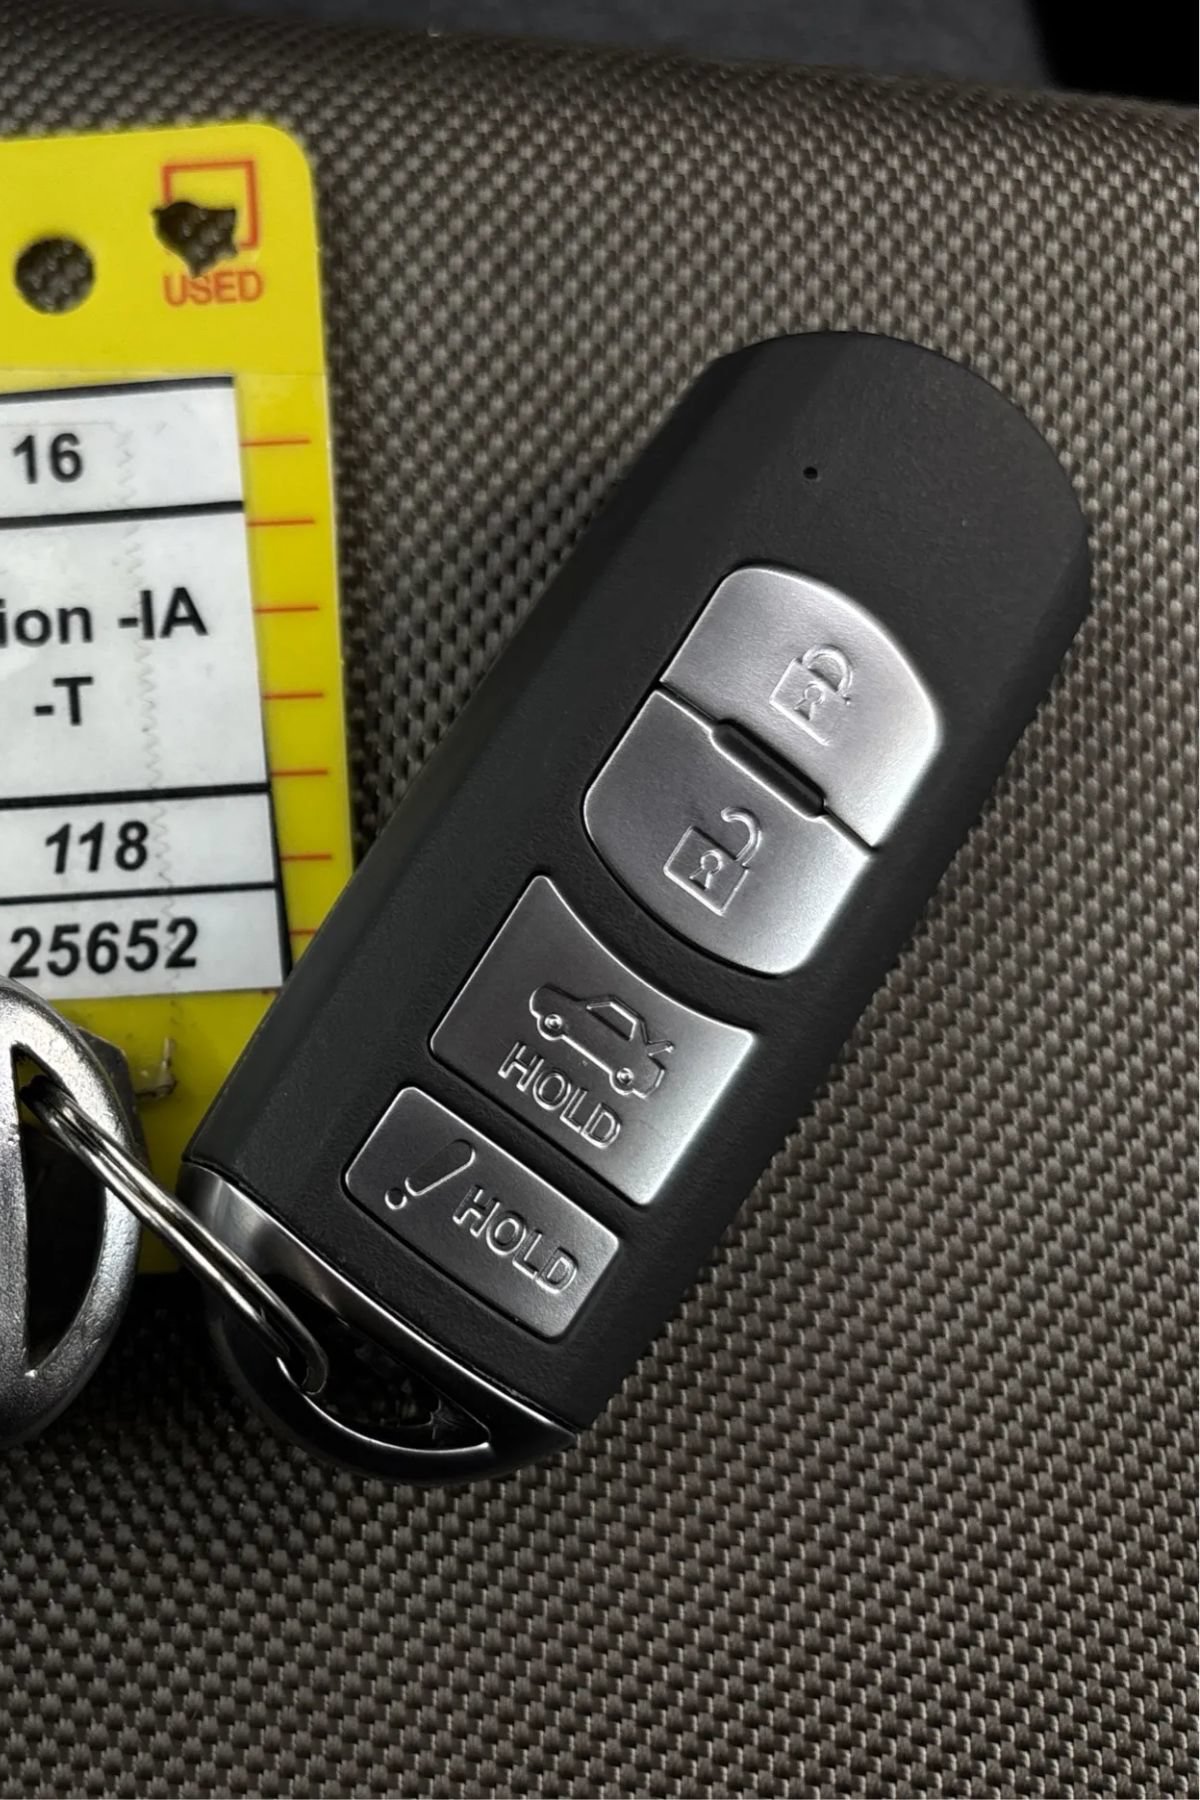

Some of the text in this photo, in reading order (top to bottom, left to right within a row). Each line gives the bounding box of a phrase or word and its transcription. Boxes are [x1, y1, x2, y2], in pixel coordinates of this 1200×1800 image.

[163, 269, 264, 307] USED
[12, 432, 84, 485] 16
[118, 586, 208, 641] -IA
[34, 676, 94, 726] -T
[44, 820, 150, 875] 118
[497, 1039, 623, 1150] HOLD
[451, 1183, 579, 1295] HOLD
